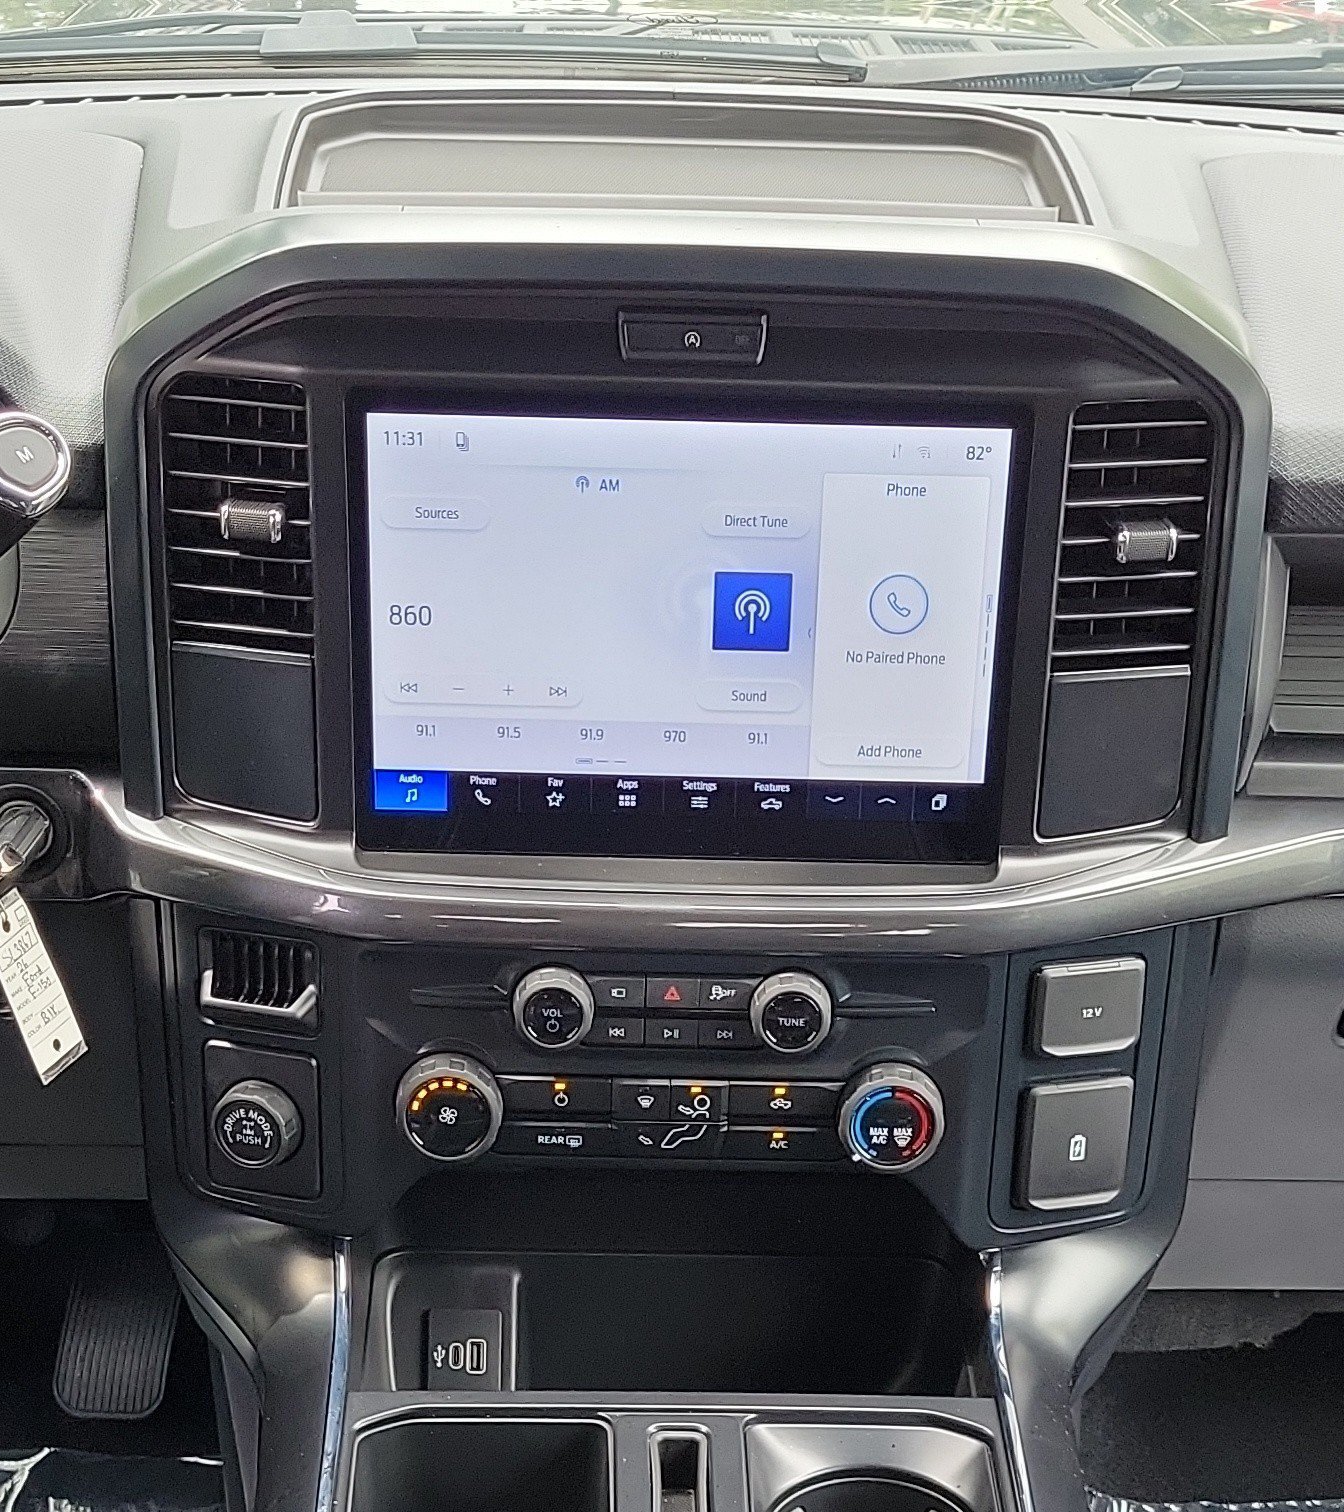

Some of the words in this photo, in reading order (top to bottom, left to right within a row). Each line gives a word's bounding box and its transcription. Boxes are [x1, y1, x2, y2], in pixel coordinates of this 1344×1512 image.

[382, 430, 425, 447] 11:31
[15, 446, 35, 464] M
[964, 445, 993, 462] 82°
[599, 478, 621, 493] AM
[886, 482, 927, 499] Phone
[414, 506, 459, 521] Sources
[724, 514, 755, 529] Direct
[757, 514, 788, 529] Tune
[388, 604, 432, 628] 860
[845, 651, 859, 666] No
[862, 651, 904, 666] Paired
[907, 651, 946, 667] Phone
[731, 688, 768, 704] Sound
[415, 724, 437, 739] 91.1
[496, 726, 521, 741] 91.5
[579, 728, 605, 742] 91.9
[662, 729, 687, 744] 970
[747, 731, 769, 746] 91.1
[856, 745, 879, 759] Add
[882, 745, 923, 760] Phone
[399, 774, 423, 784] Audio
[469, 775, 497, 787] Phone
[547, 777, 564, 788] Fav
[616, 779, 639, 790] Apps
[682, 781, 718, 792] Settings
[754, 782, 791, 793] Features
[721, 989, 737, 997] OFF
[542, 1008, 563, 1018] VOL
[777, 1017, 806, 1027] TUNE
[223, 1108, 247, 1133] DRIVE
[247, 1108, 273, 1138] MODE
[869, 1127, 889, 1137] MAX
[893, 1127, 913, 1137] MAX
[236, 1133, 262, 1147] PUSH
[537, 1134, 565, 1146] REAR
[769, 1140, 789, 1150] A/C
[871, 1135, 889, 1145] A/C
